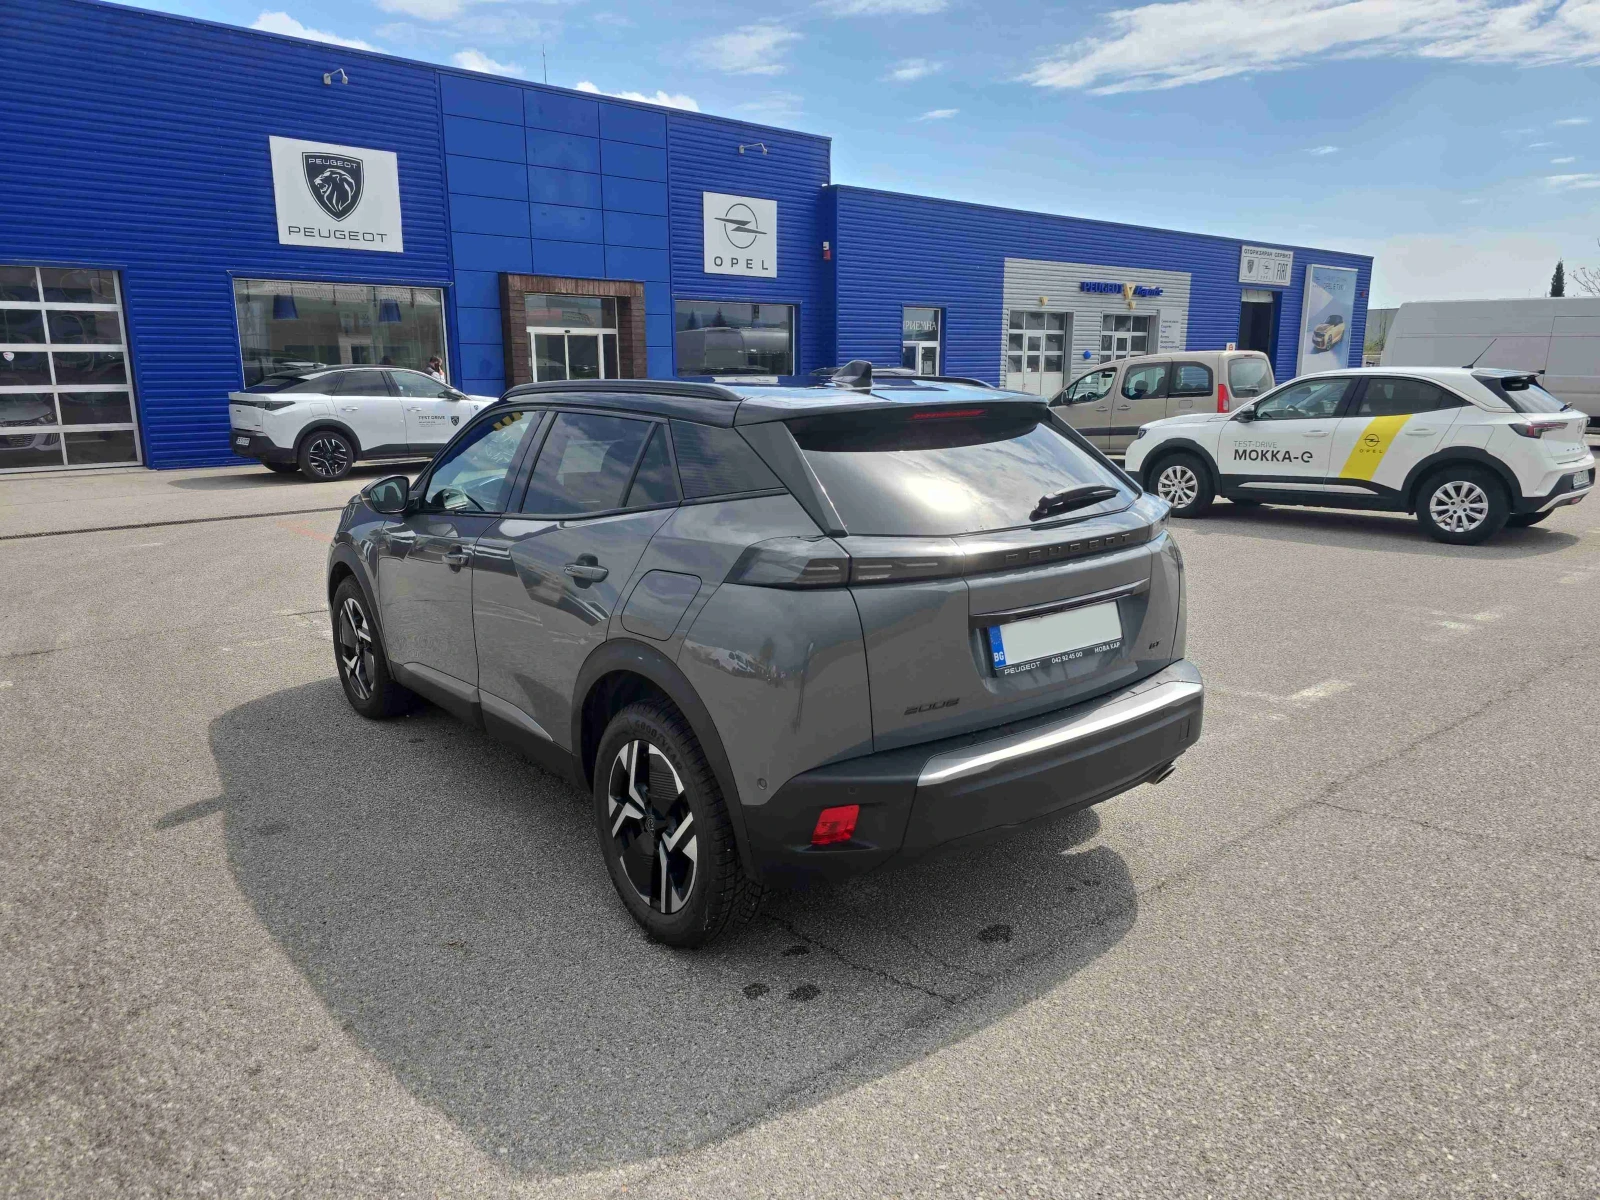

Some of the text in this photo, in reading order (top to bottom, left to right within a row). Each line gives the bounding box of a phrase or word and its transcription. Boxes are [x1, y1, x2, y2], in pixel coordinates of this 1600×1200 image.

[308, 158, 358, 169] PEUGEOT
[288, 225, 387, 243] PEUGEOT
[714, 255, 769, 271] OPEL
[1233, 440, 1278, 449] TEST-DRIVE
[1004, 533, 1130, 562] PEUGEOT
[1094, 641, 1121, 654] НОВА КАР
[993, 651, 1005, 662] BG
[1051, 656, 1061, 664] 042
[1004, 661, 1041, 675] PEUGEOT
[904, 698, 960, 715] 2008
